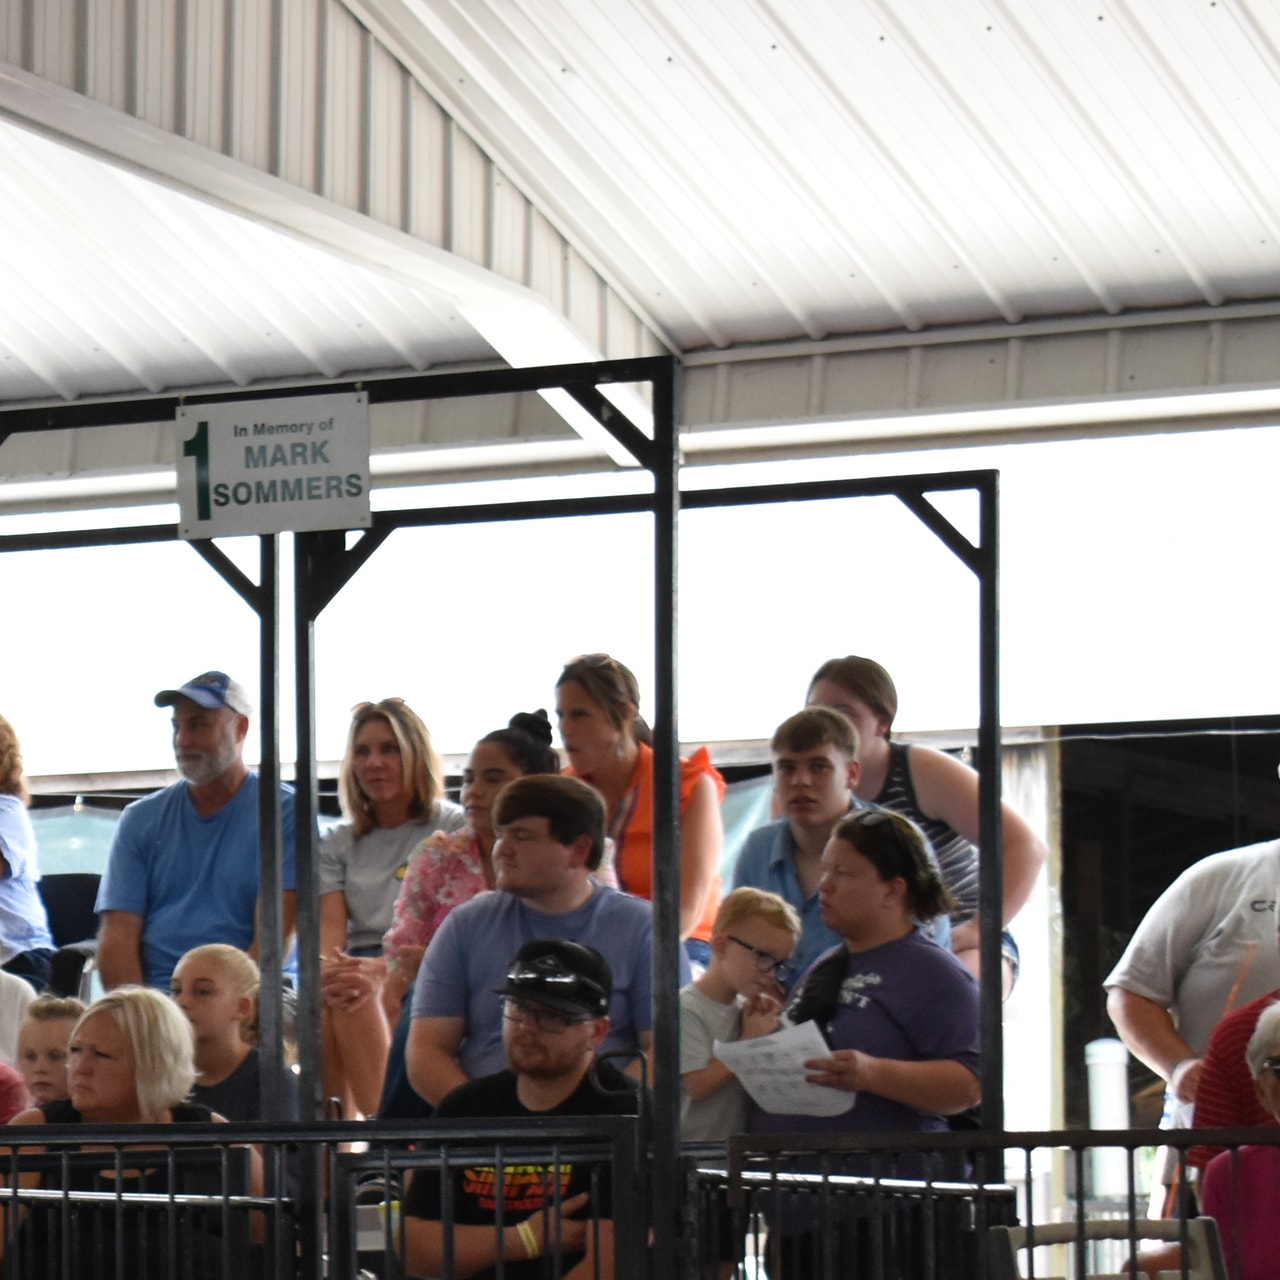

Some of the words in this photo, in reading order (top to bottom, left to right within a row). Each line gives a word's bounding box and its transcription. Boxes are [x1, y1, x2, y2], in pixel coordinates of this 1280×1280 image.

[234, 424, 248, 437] In
[252, 421, 314, 436] Memory
[319, 418, 335, 431] of
[244, 440, 330, 469] MARK
[183, 421, 211, 521] 1
[213, 473, 363, 507] SOMMERS
